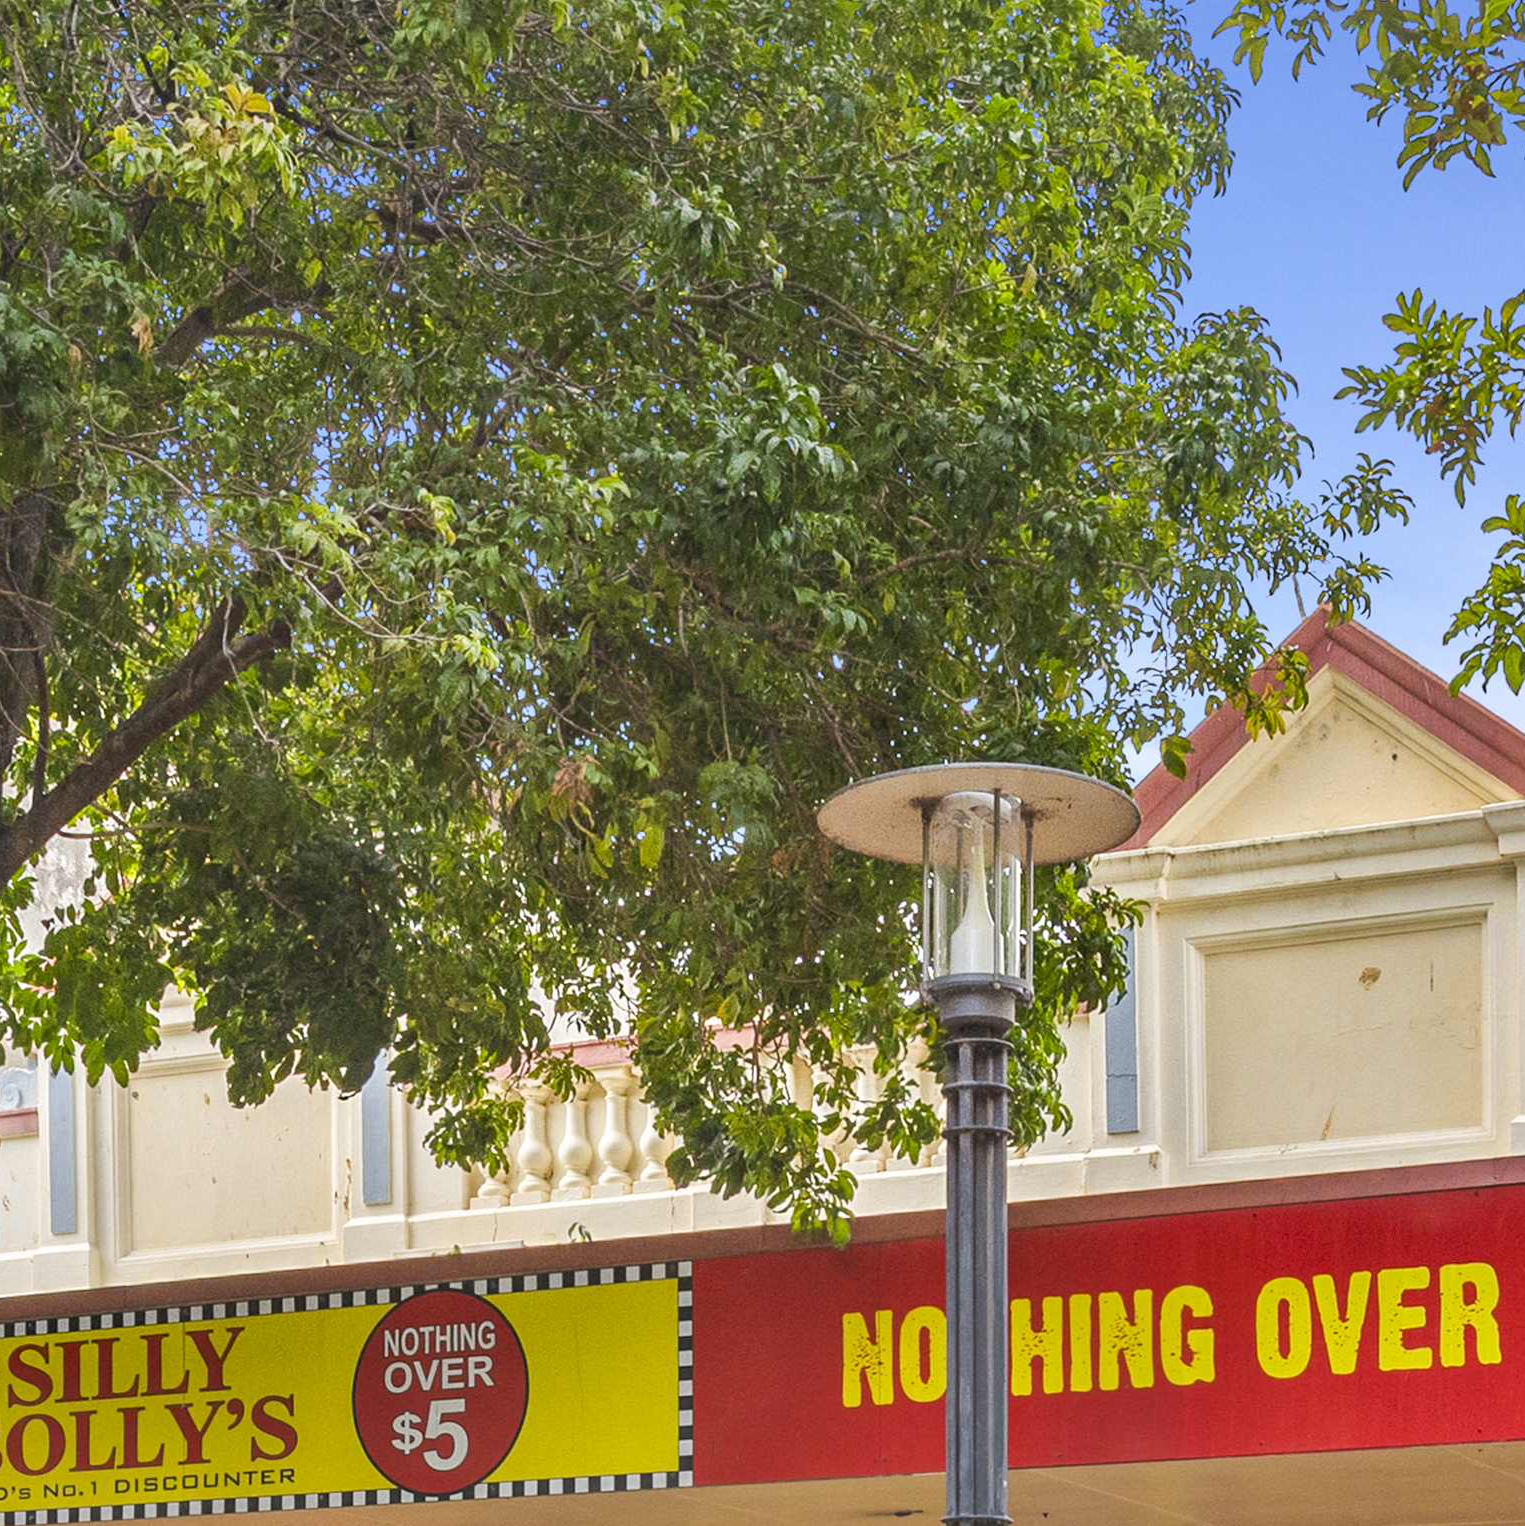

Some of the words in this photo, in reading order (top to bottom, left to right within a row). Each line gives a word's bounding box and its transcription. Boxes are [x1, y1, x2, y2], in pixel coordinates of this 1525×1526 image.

[384, 1320, 496, 1357] NOTHING
[842, 1285, 1216, 1408] NOHING
[1255, 1262, 1503, 1379] OVER
[8, 1327, 245, 1407] SILLY
[384, 1355, 495, 1394] OVER
[391, 1398, 469, 1471] $5
[44, 1481, 98, 1498] No.1
[115, 1469, 295, 1493] DISCOUNTER
